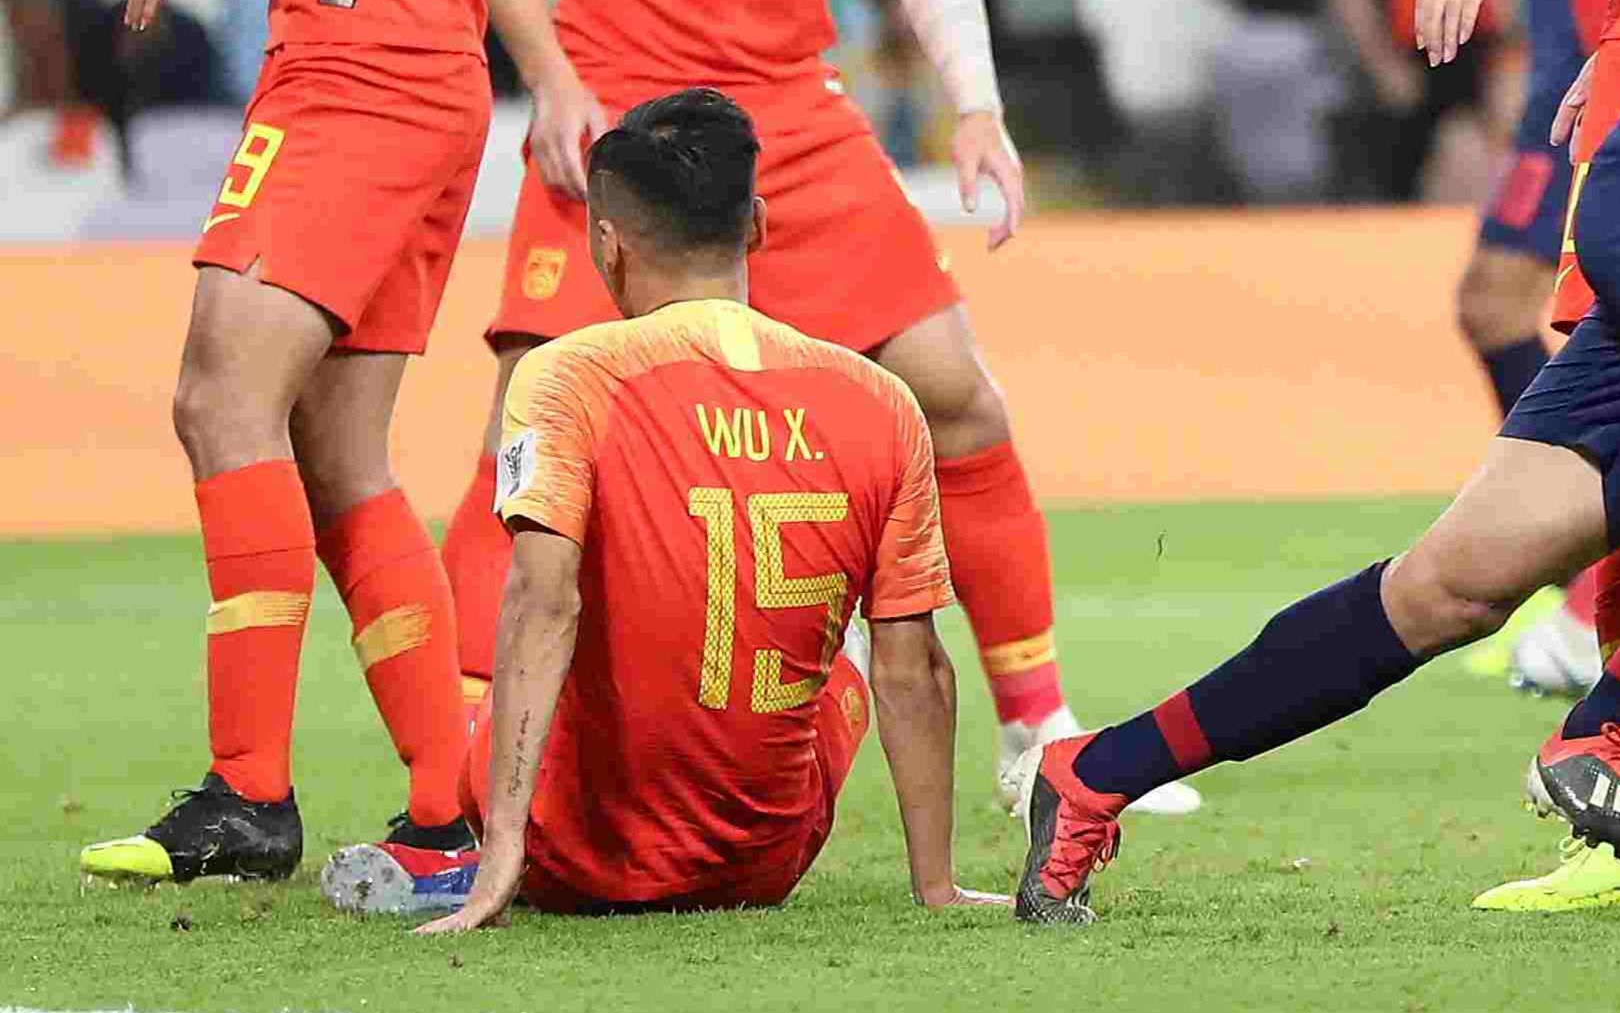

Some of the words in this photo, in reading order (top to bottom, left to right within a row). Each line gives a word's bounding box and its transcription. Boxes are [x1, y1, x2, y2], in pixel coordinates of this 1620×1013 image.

[218, 122, 287, 208] 9
[695, 402, 771, 461] WU
[783, 407, 825, 461] X.
[688, 487, 849, 713] 15
